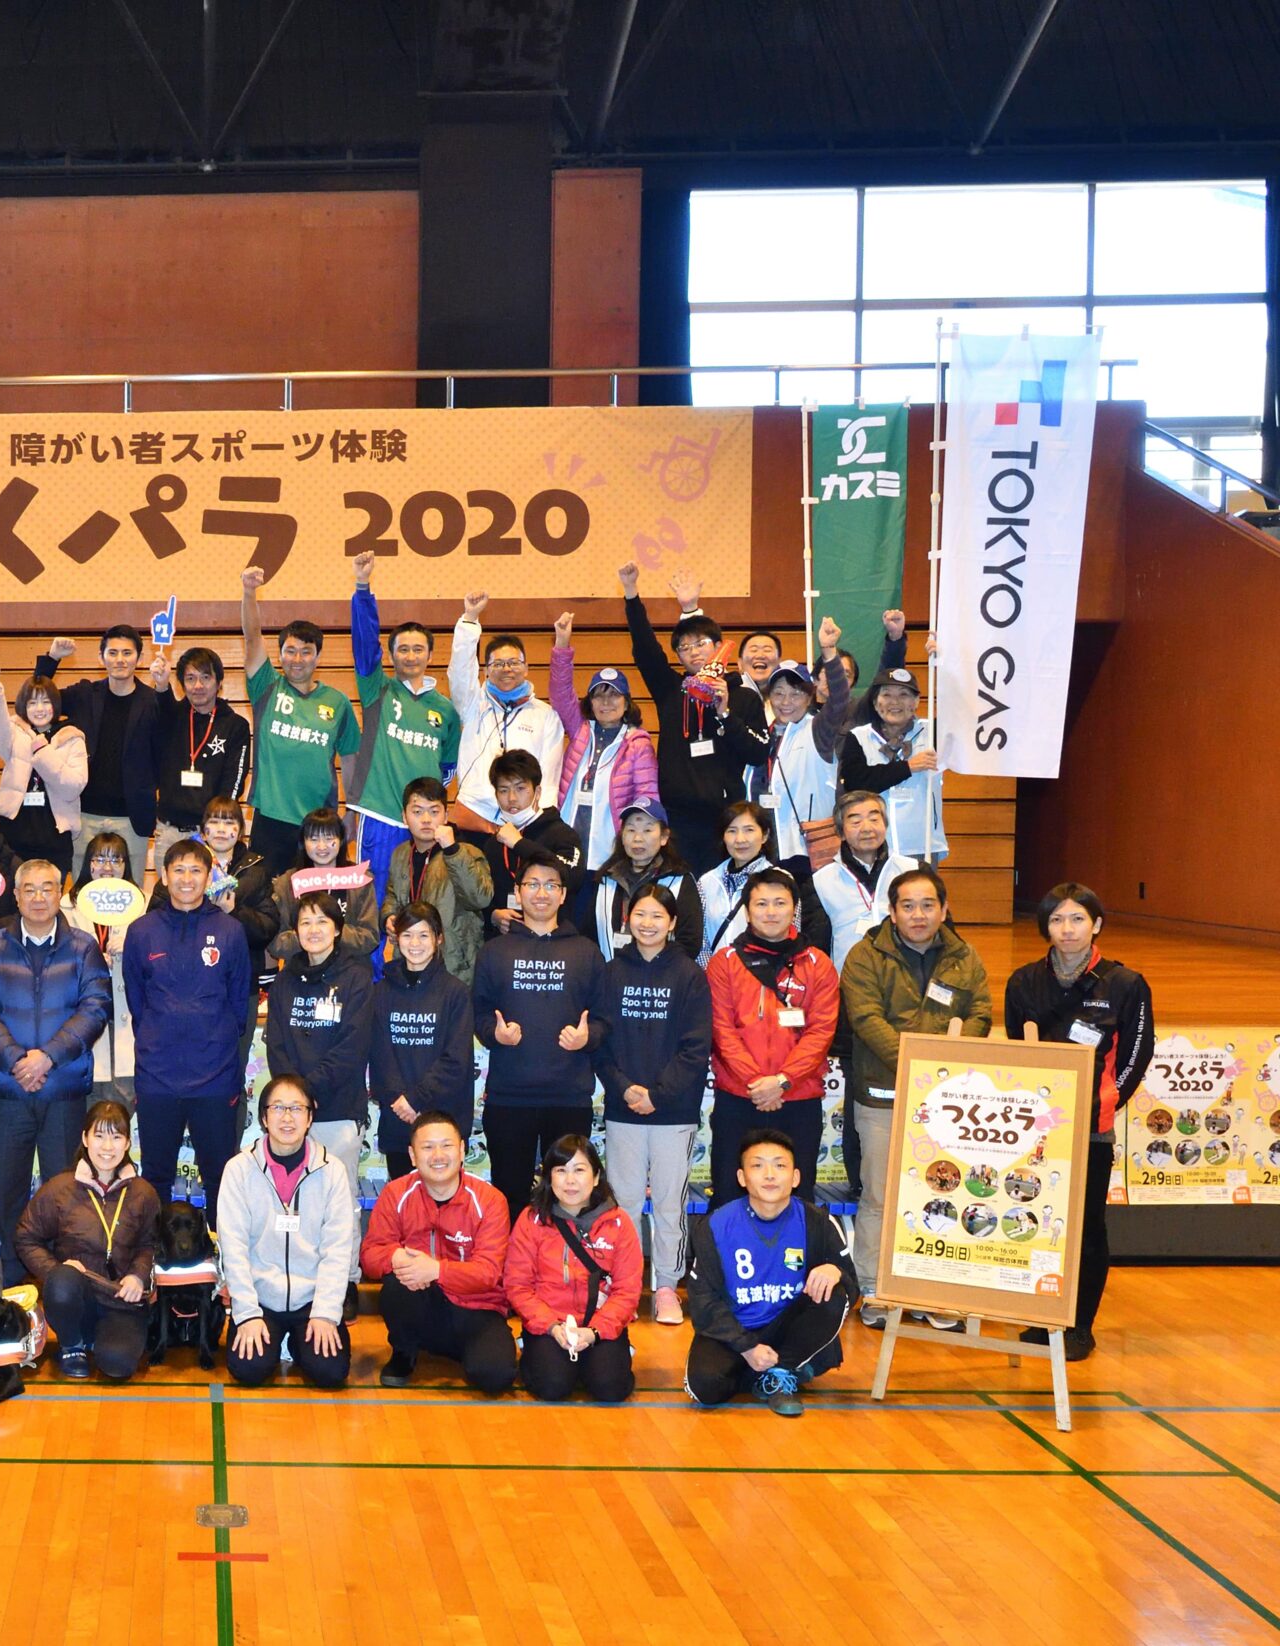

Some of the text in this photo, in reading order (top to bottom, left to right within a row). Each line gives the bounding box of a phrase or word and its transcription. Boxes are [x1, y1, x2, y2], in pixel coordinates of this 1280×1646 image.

[10, 429, 408, 467] 障がい者スポーツ体験
[821, 471, 900, 501] カスミ
[343, 488, 591, 558] 2020
[975, 441, 1038, 753] TOKYO GAS
[155, 624, 169, 637] #1
[275, 693, 294, 715] 16
[292, 873, 364, 891] Para-Sports
[97, 902, 125, 912] 2020
[206, 935, 216, 945] 59
[514, 959, 565, 970] IBARAKI
[513, 970, 564, 981] Sports for
[513, 981, 564, 992] Everyone!
[623, 986, 671, 998] IBARAKI
[622, 997, 669, 1008] Sports for
[1083, 1000, 1110, 1009] TSUKUBA
[390, 1012, 436, 1024] IBARAKI
[622, 1008, 668, 1020] Everyone!
[390, 1024, 435, 1034] Sports for
[392, 1035, 434, 1046] Everyone!
[1155, 1061, 1225, 1079] つくパラ
[1168, 1080, 1213, 1092] 2020
[942, 1103, 1036, 1131] つくパラ
[958, 1126, 1019, 1145] 2020
[1142, 1171, 1184, 1186] 2月9日(日)
[914, 1237, 971, 1261] 2月9日(日)
[735, 1248, 755, 1280] 8
